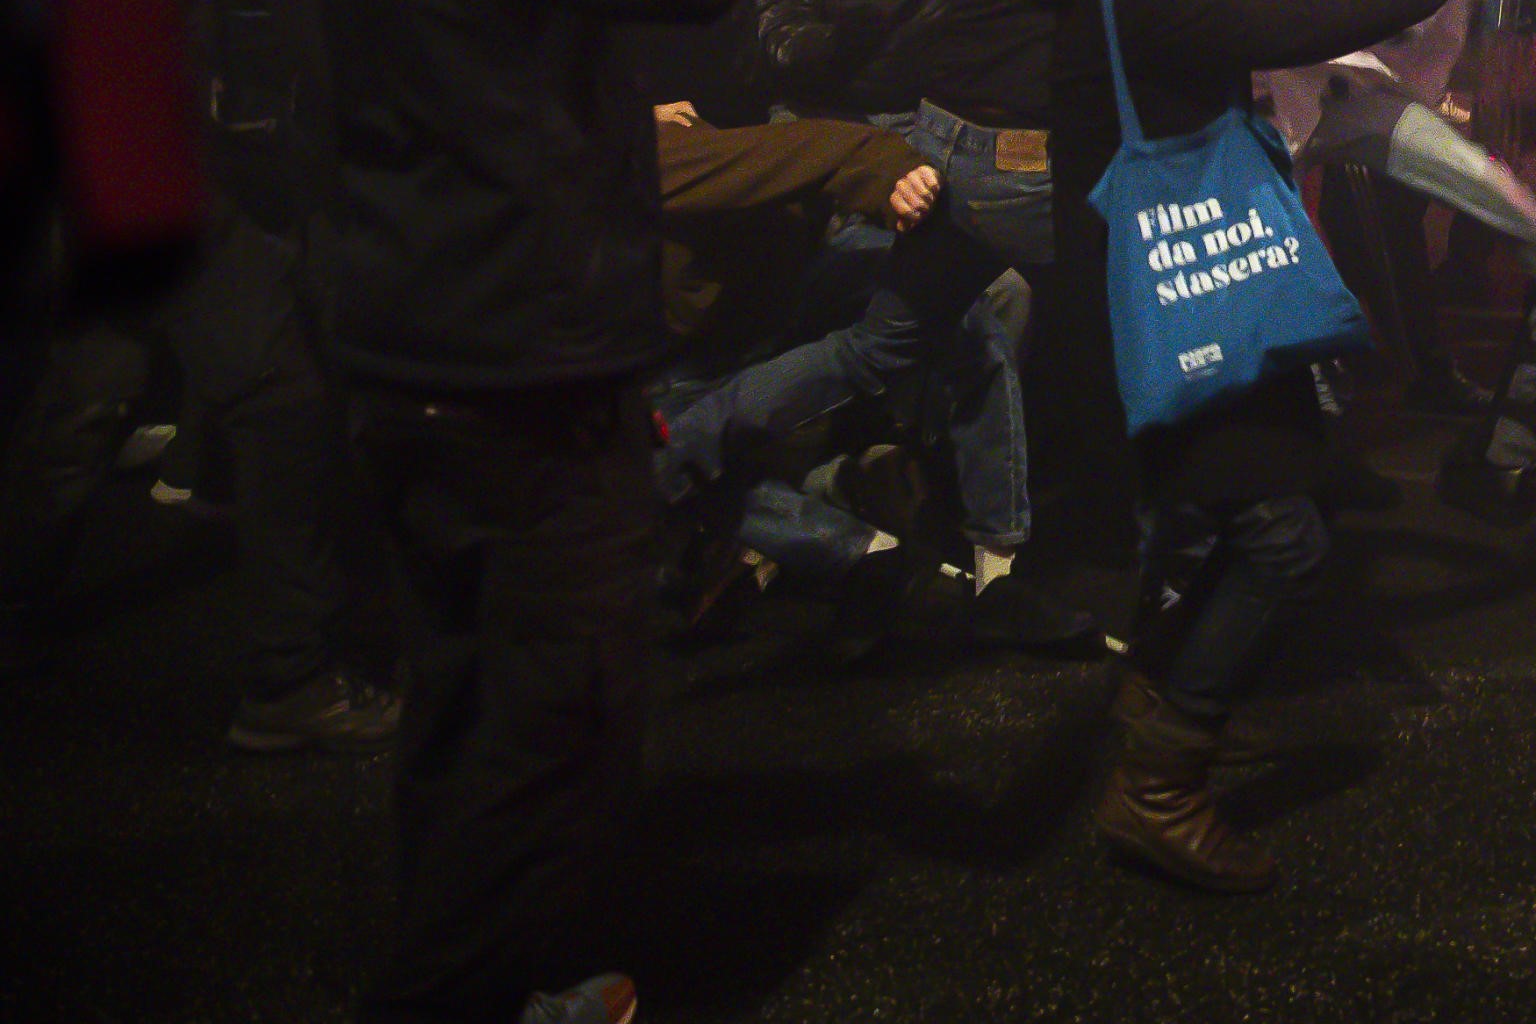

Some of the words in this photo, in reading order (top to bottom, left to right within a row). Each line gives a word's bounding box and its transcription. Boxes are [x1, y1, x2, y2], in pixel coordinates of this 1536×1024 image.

[1137, 197, 1224, 241] Film
[1147, 239, 1198, 272] da
[1155, 236, 1301, 306] stasera?
